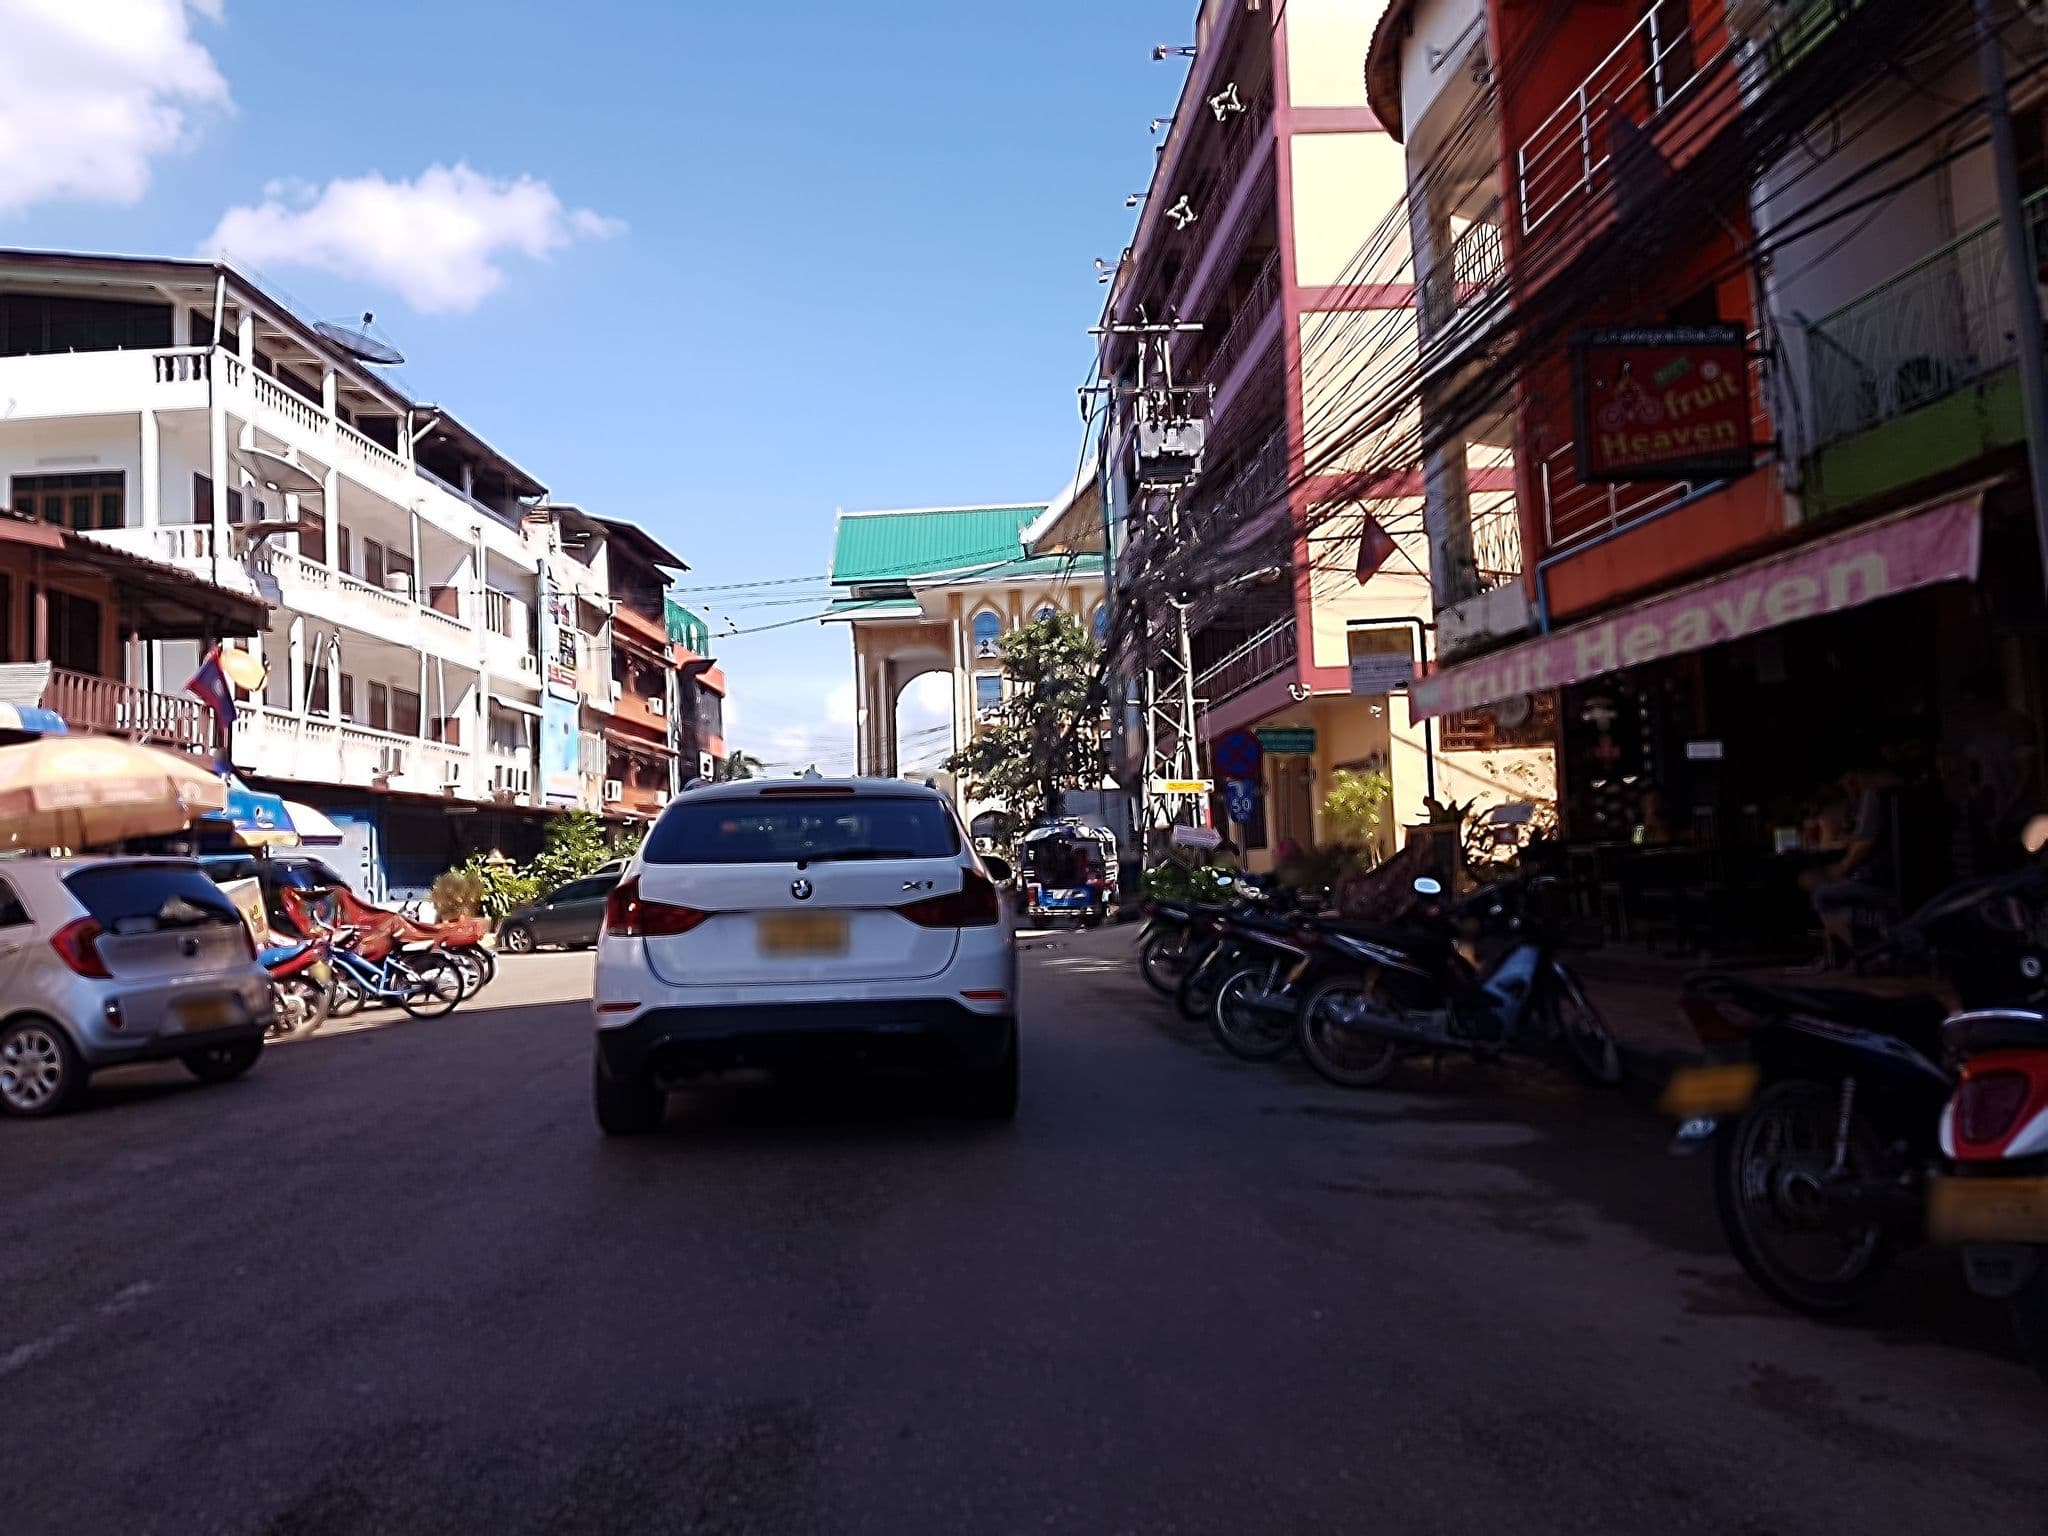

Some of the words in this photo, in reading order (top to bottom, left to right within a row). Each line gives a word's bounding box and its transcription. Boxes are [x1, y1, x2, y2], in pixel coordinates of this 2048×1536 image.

[1663, 372, 1741, 419] fruit
[1601, 419, 1738, 457] Heaven
[1573, 550, 1887, 673] Heaven
